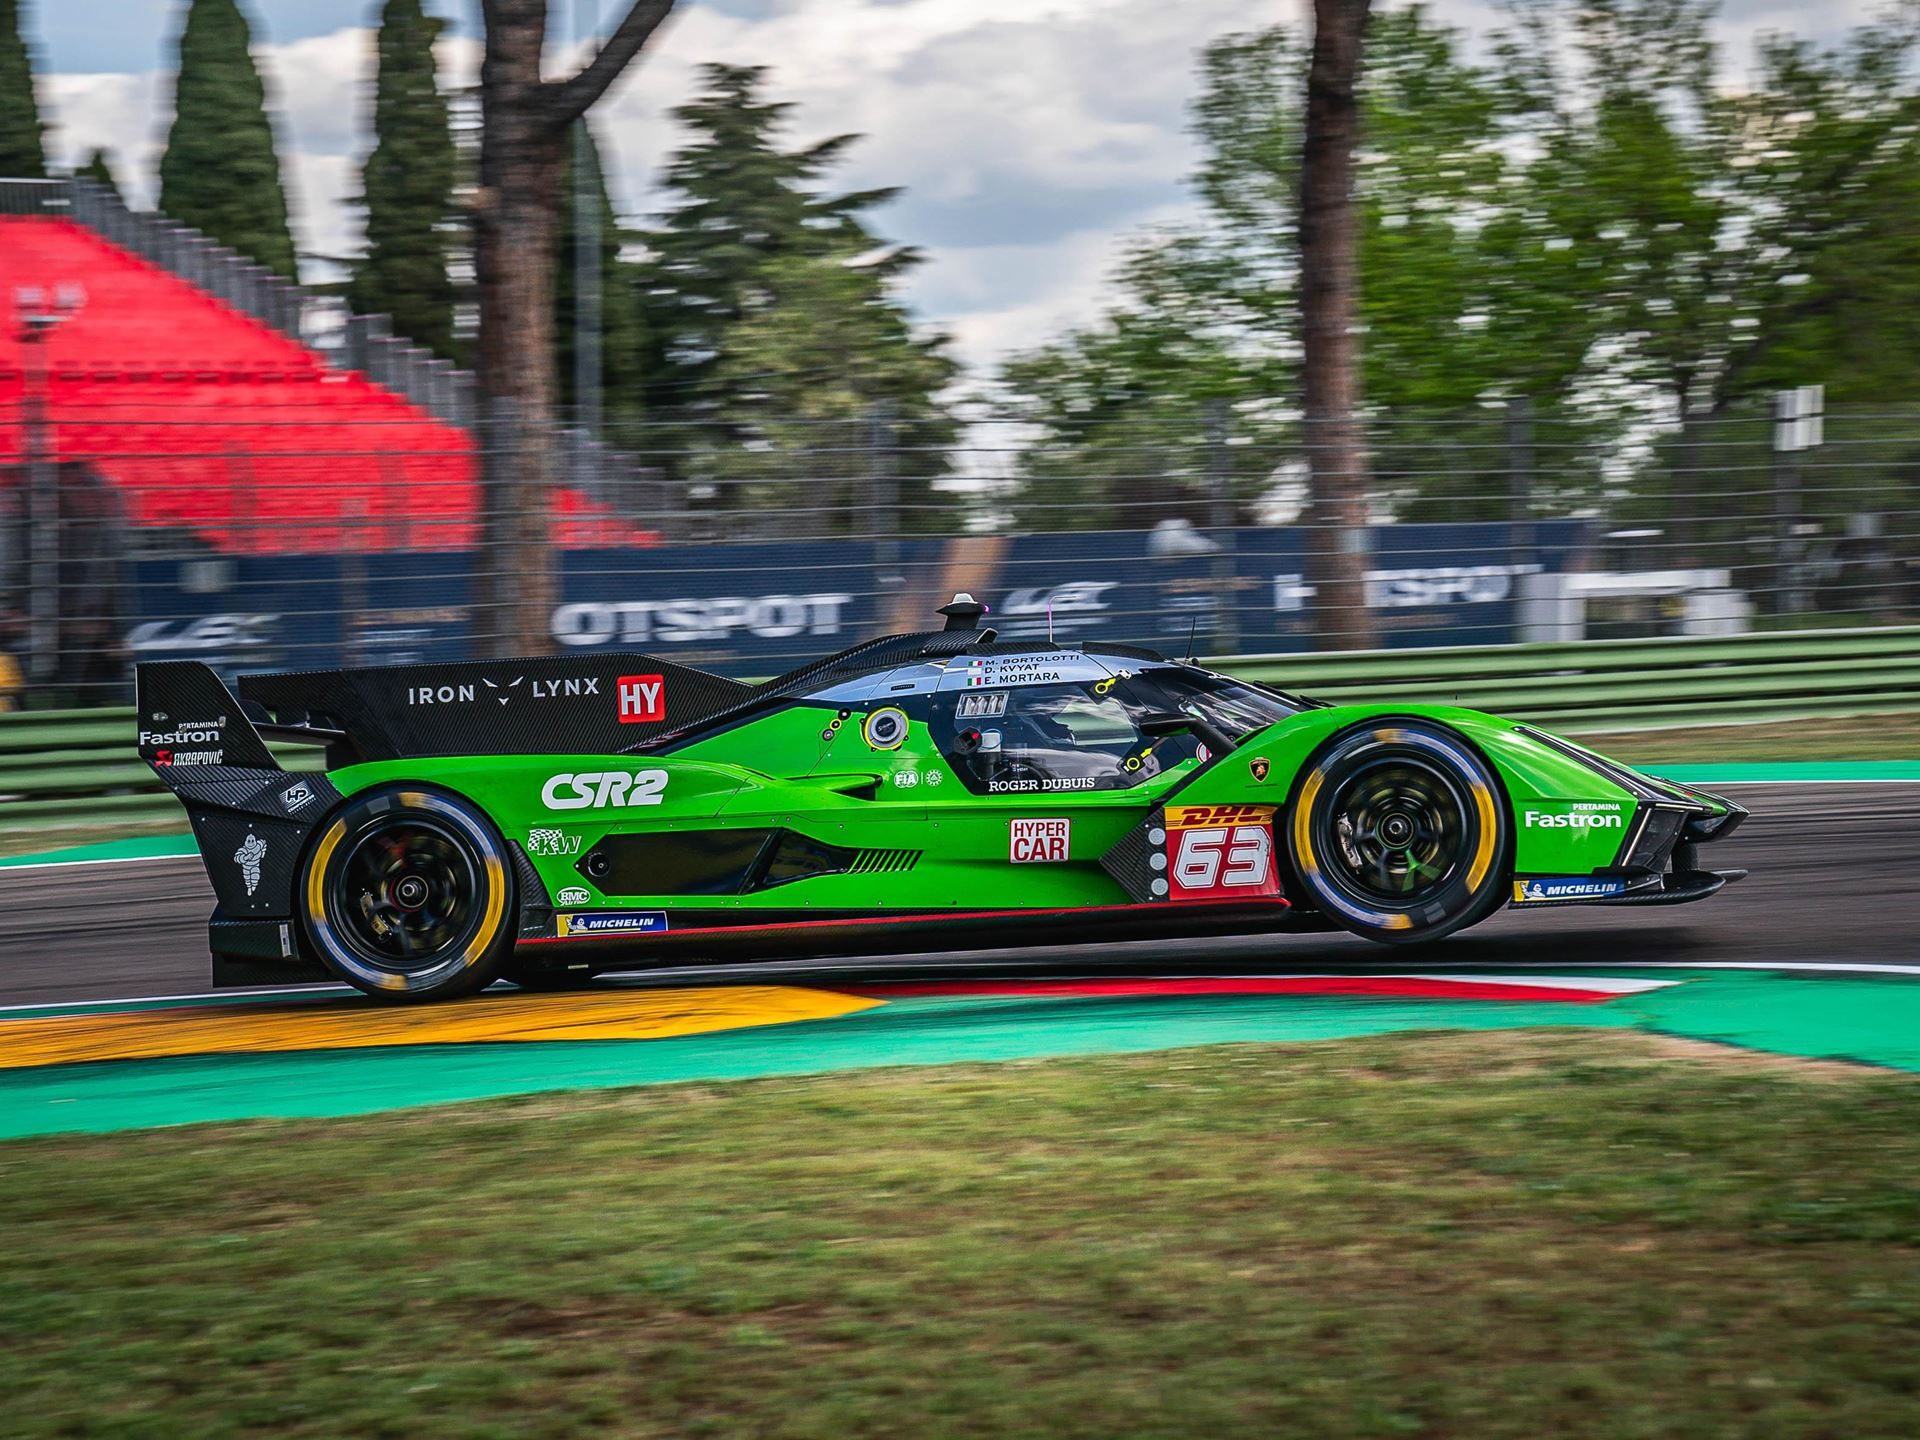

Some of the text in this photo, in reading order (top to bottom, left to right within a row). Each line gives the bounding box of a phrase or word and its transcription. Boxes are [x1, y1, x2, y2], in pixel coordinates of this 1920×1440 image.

[552, 594, 853, 645] OTSPOT
[1003, 655, 1079, 664] BORTOLOTTI
[1000, 664, 1039, 672] KVYAT
[984, 672, 1060, 685] E. MORTARA
[409, 678, 599, 704] IRON LYNX
[620, 682, 661, 715] HY
[140, 730, 219, 745] Fastron
[542, 769, 669, 810] CSR2
[989, 778, 1095, 792] ROGER DUBUIS
[1572, 803, 1621, 811] PERTAMINA
[1181, 806, 1264, 826] DHL
[1525, 811, 1622, 828] Fastron
[1014, 822, 1066, 837] HYPER
[537, 835, 582, 856] KW
[1013, 837, 1065, 861] CAR
[1173, 825, 1272, 889] 63
[561, 892, 587, 901] BMC
[1546, 883, 1617, 895] MICHELIN
[588, 918, 654, 929] MICHELIN
